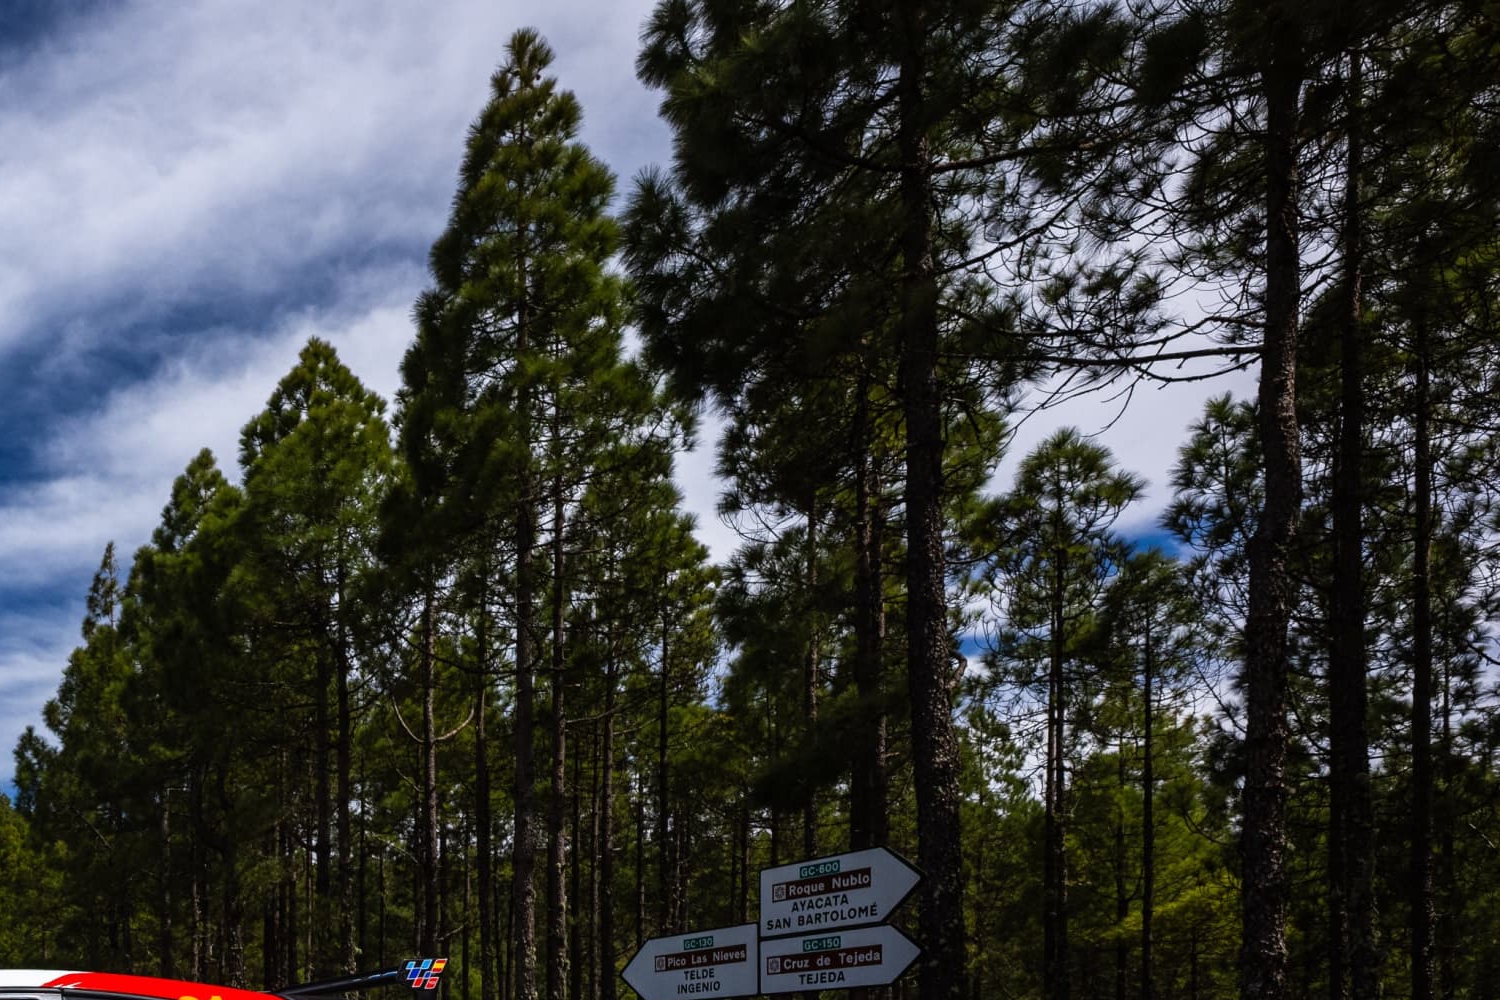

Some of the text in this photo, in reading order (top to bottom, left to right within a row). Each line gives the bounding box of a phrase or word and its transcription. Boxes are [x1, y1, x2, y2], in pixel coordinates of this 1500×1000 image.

[801, 862, 839, 877] GC-600
[789, 874, 870, 896] Roque Nublo
[791, 894, 849, 912] AYACATA
[767, 902, 878, 931] SAN BARTOLOMÉ
[684, 938, 713, 949] GC-130
[804, 938, 840, 951] GC-150
[667, 950, 746, 968] Pico Las Nieves
[783, 949, 881, 971] Cruz de Tejeda
[684, 968, 715, 981] TELDE
[798, 971, 845, 985] TEJEDA
[677, 981, 721, 994] INGENIO
